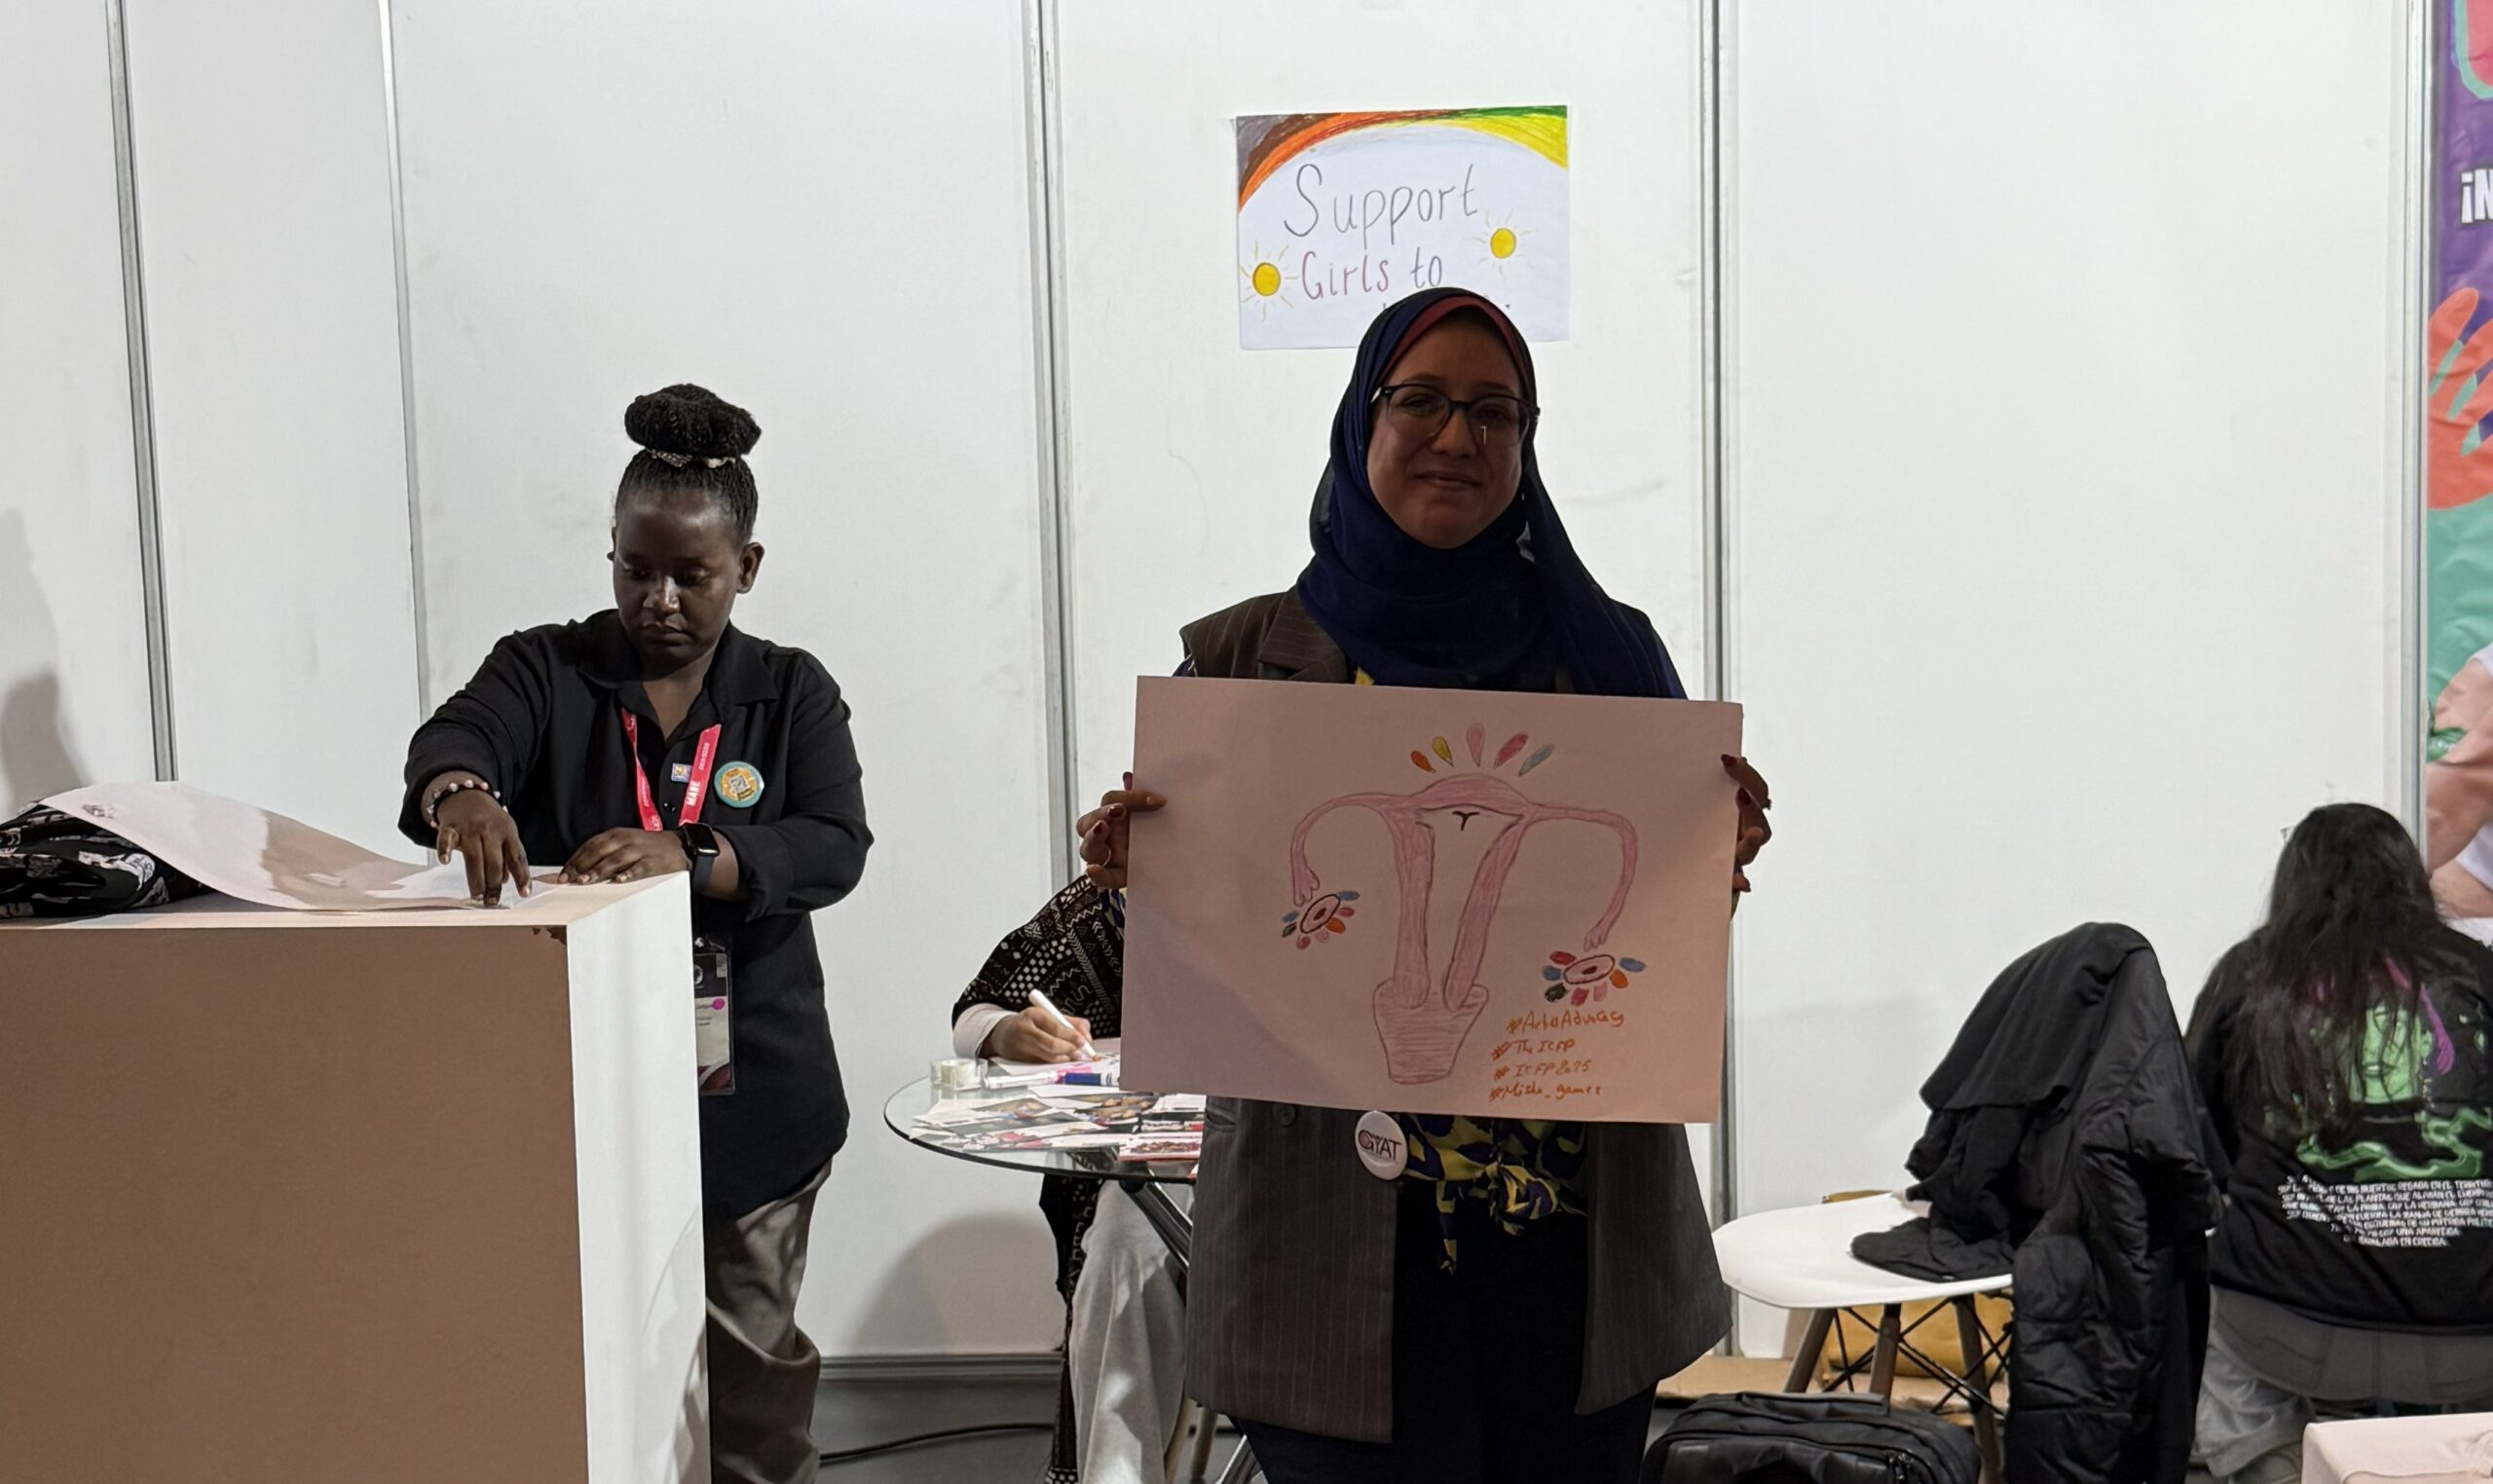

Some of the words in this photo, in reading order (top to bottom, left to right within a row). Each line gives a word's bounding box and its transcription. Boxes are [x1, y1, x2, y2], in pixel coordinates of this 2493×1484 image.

[1284, 164, 1478, 249] Support
[1301, 251, 1390, 300] Girls
[1410, 246, 1443, 289] to
